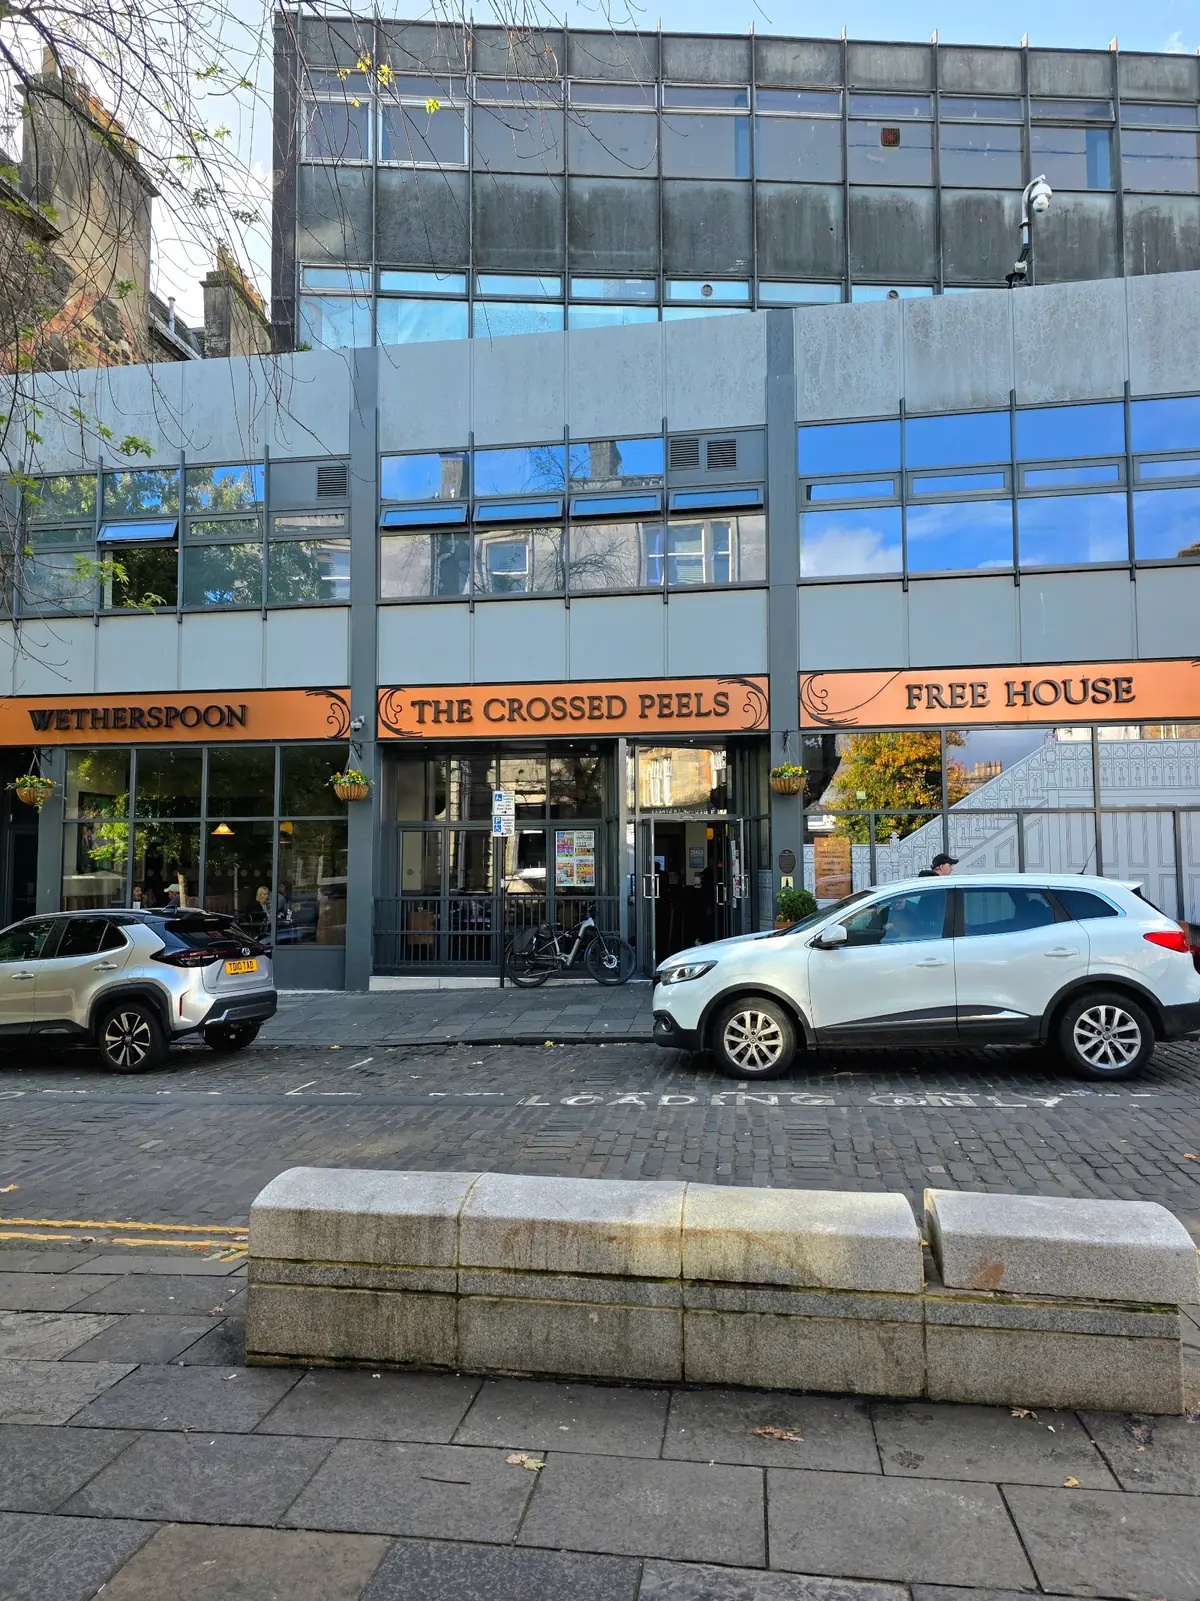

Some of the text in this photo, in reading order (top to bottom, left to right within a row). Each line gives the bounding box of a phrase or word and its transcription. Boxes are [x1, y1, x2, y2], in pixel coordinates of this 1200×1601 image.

[410, 691, 730, 723] THE CROSSED PEELS
[905, 676, 1136, 710] FREE HOUSE
[28, 704, 248, 732] WETHERSPOON
[519, 1092, 1063, 1108] LOADING ONLY
